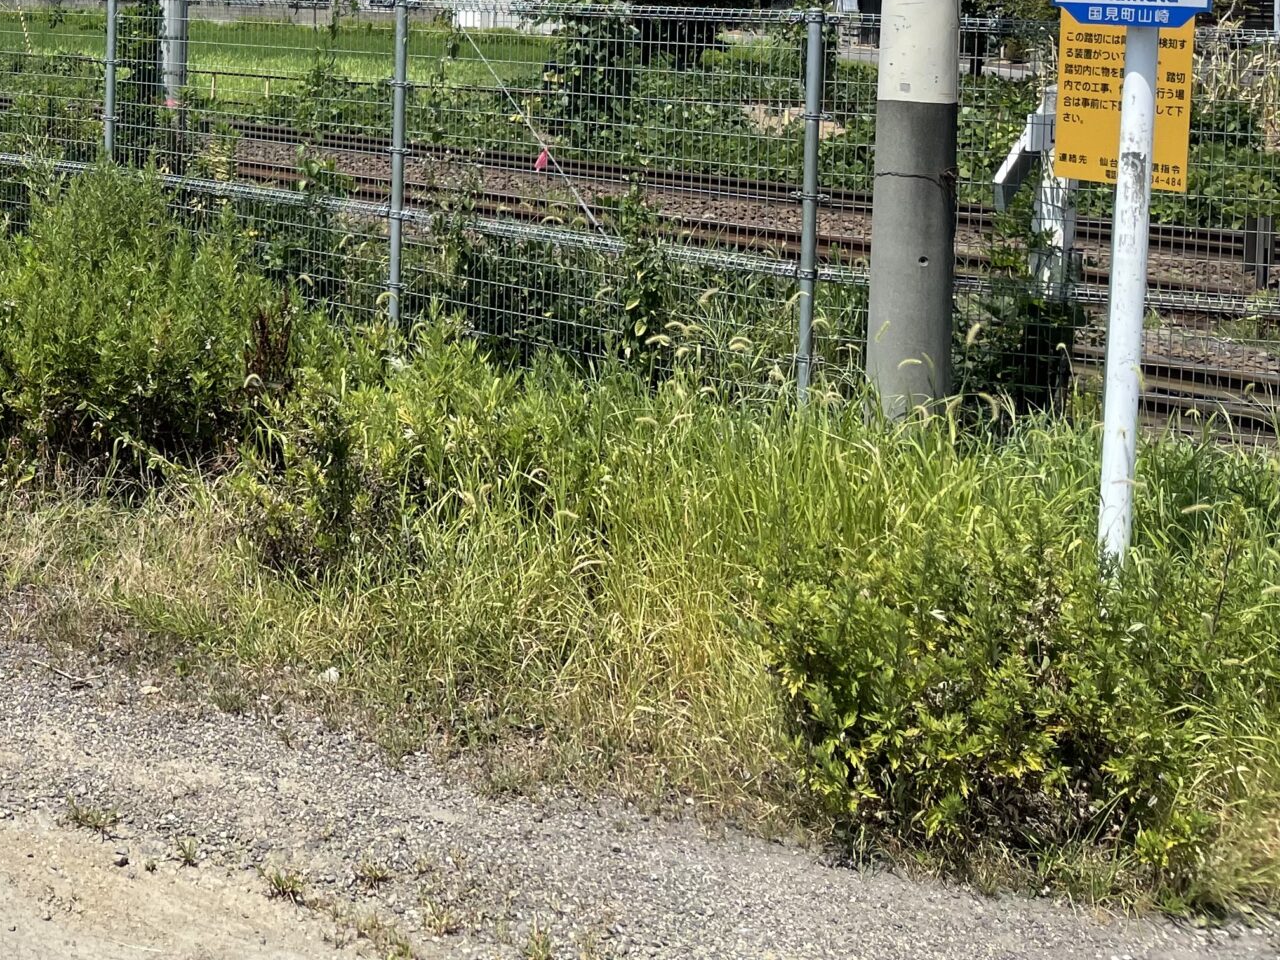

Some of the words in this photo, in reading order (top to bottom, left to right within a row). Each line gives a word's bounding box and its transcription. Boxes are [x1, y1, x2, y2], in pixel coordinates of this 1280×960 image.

[1088, 6, 1170, 23] 国見町山崎
[1062, 112, 1084, 124] さい。
